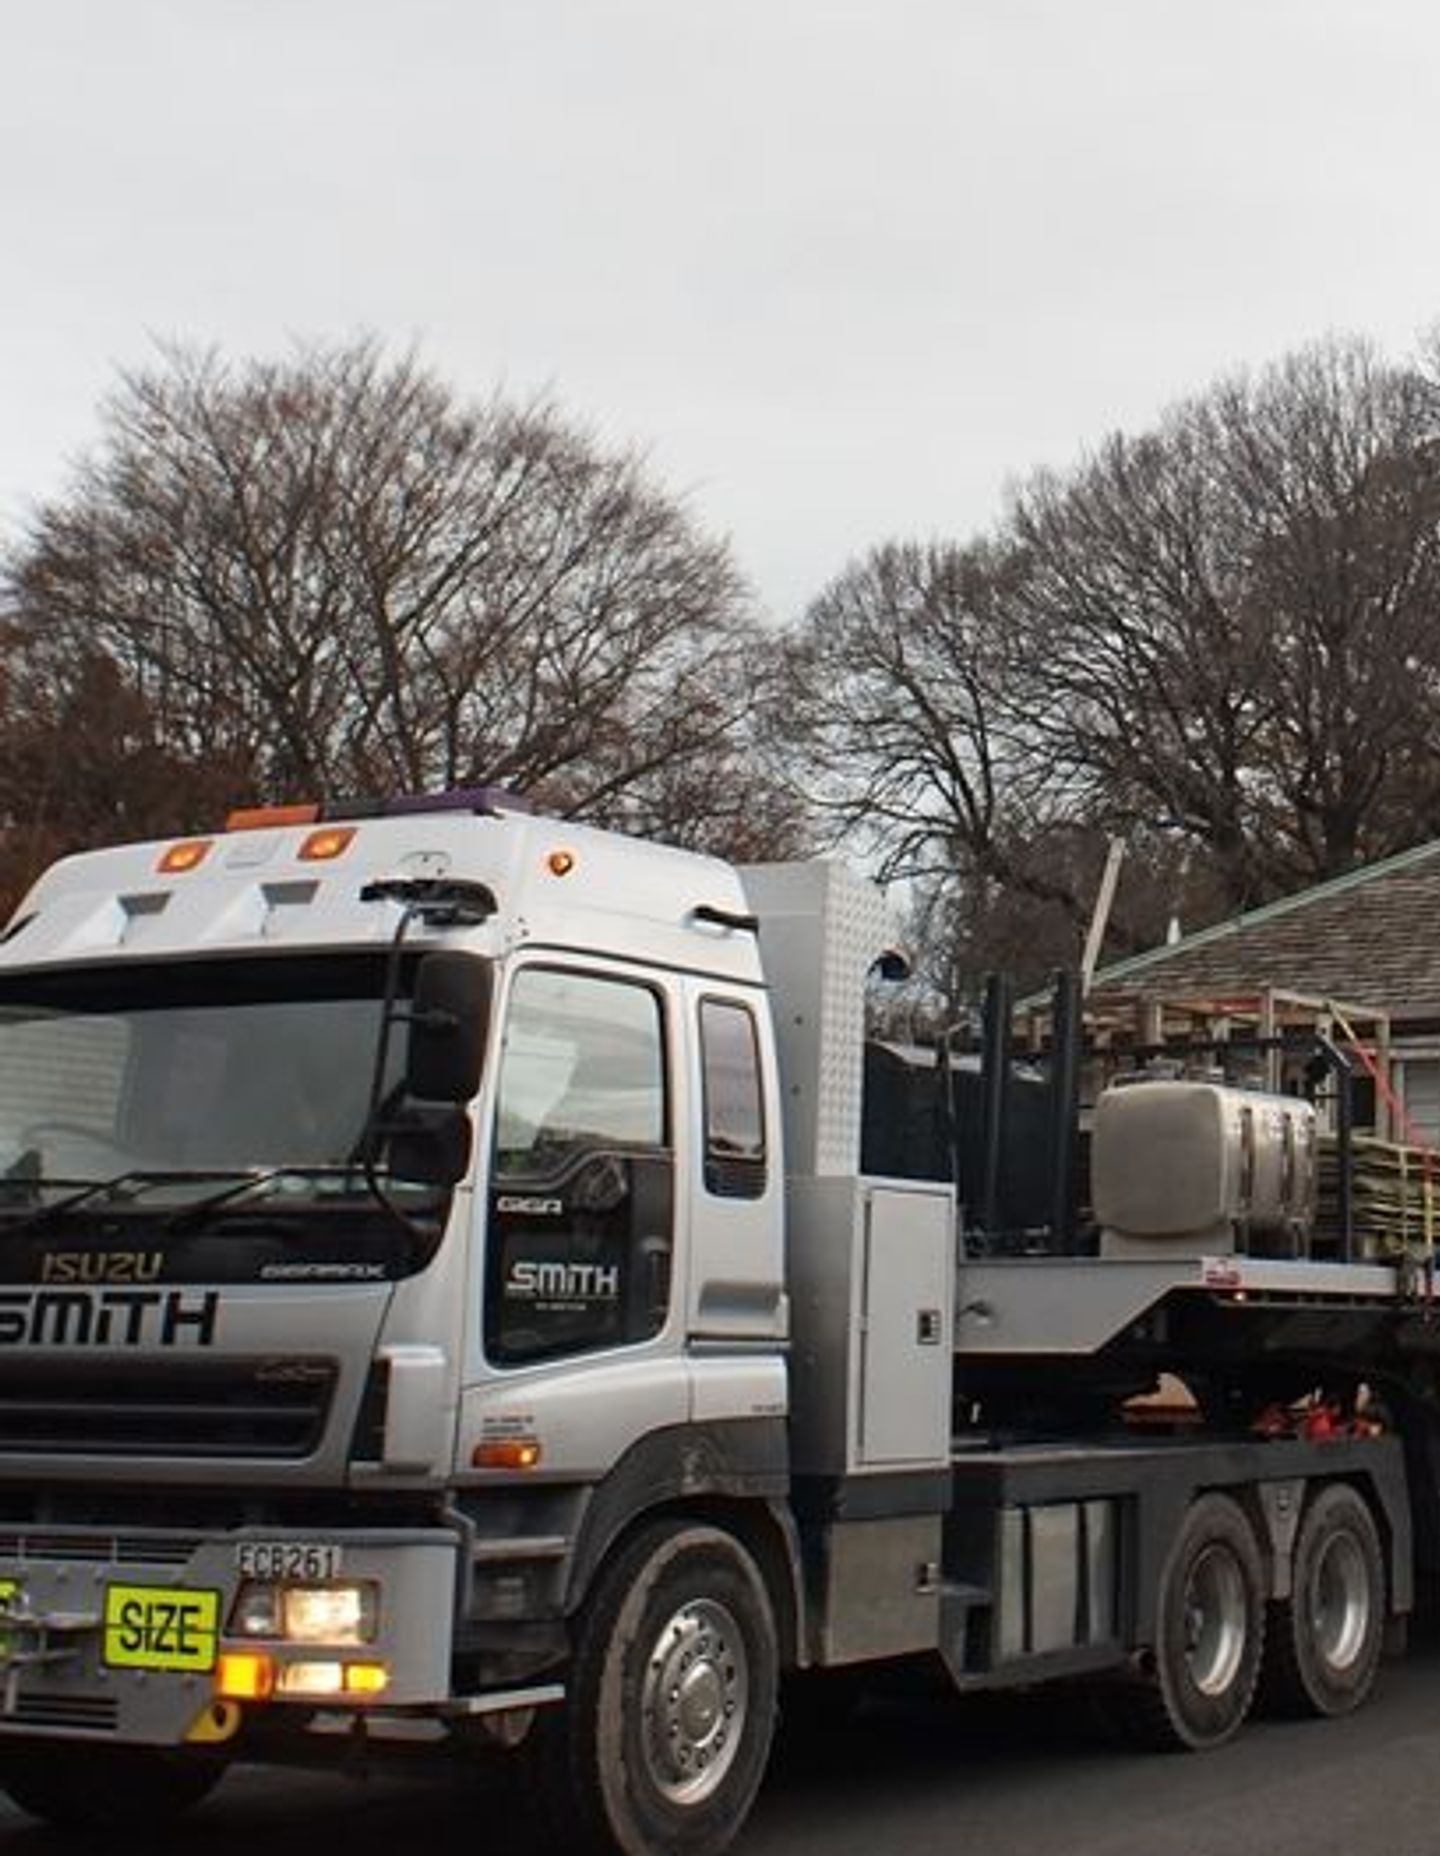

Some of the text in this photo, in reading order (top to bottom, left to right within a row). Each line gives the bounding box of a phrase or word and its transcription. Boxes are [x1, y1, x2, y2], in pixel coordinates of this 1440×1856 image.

[42, 1253, 163, 1281] ISUZU
[507, 1262, 619, 1294] SMITH
[119, 1600, 201, 1655] SIZE
